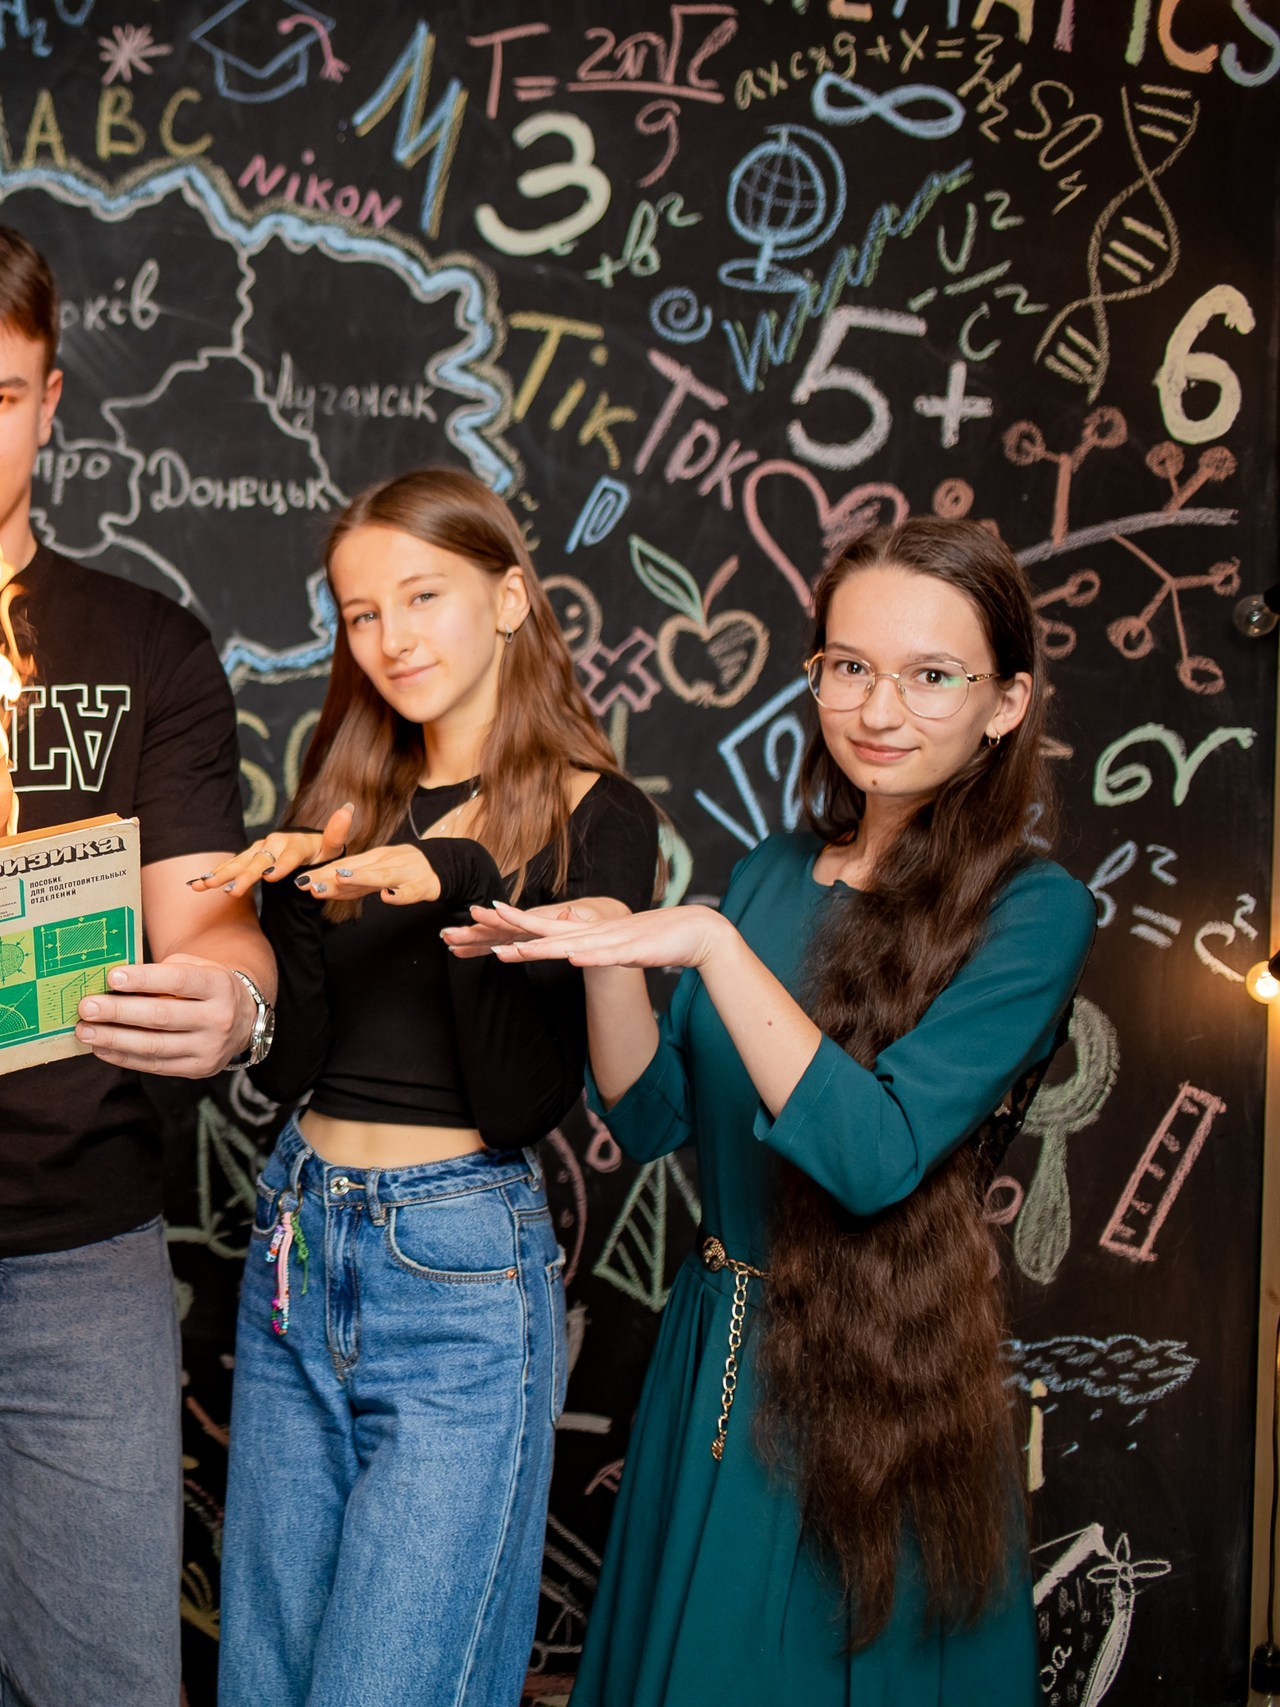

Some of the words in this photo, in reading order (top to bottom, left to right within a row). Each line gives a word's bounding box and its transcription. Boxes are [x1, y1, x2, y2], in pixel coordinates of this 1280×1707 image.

[477, 110, 611, 257] 3
[1156, 284, 1257, 444] 6
[147, 447, 331, 515] Донецьк
[29, 875, 63, 889] ПОСОБИЕ
[30, 885, 46, 898] ДЛЯ
[48, 869, 128, 892] ПОДГОТОВИТЕЛЬНЫХ
[30, 889, 77, 905] ОТДЕЛЕНИЙ
